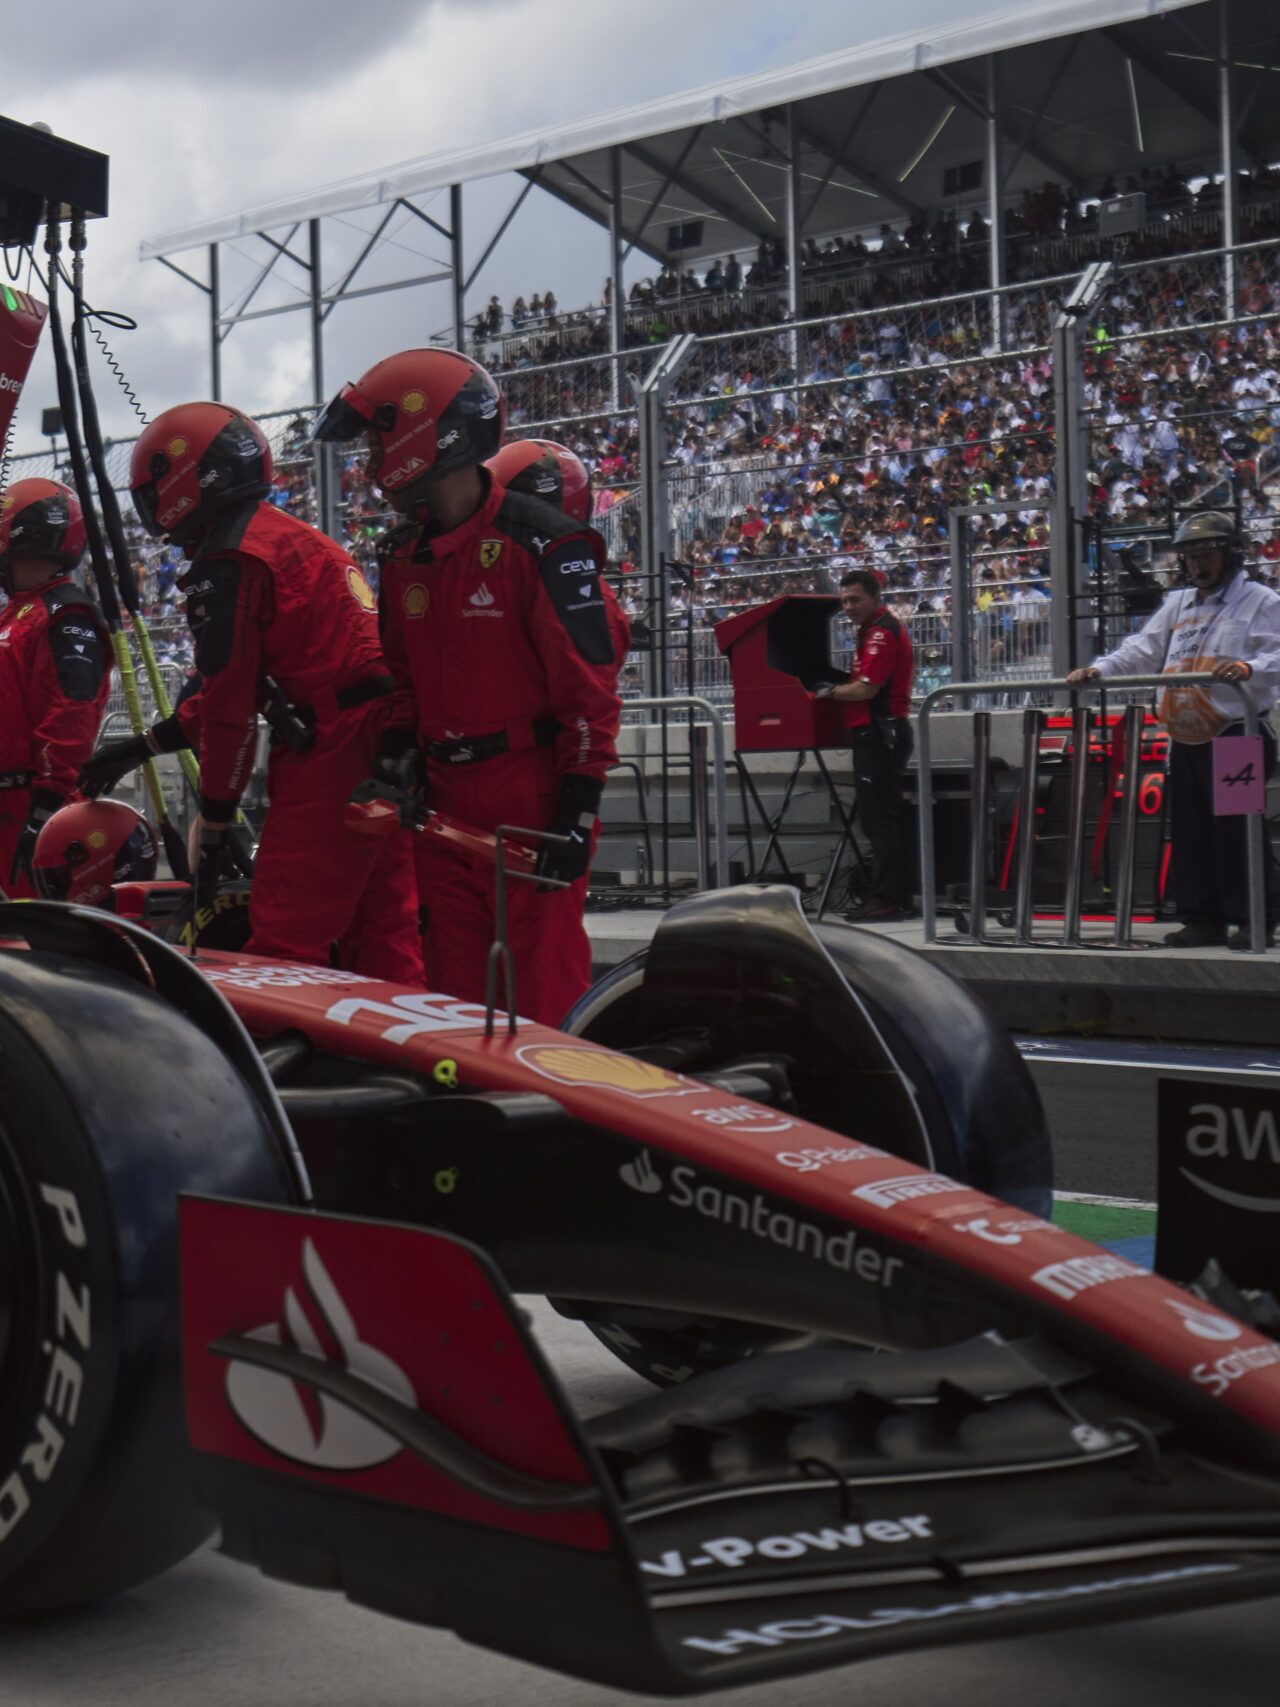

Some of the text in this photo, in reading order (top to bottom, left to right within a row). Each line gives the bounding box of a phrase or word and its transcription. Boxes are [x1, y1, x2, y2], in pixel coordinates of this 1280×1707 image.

[560, 559, 597, 575] CEVA
[62, 626, 97, 639] CEVA
[325, 993, 536, 1046] 16
[1185, 1102, 1280, 1164] aw
[669, 1166, 904, 1288] Santander
[638, 1511, 934, 1579] V-Power
